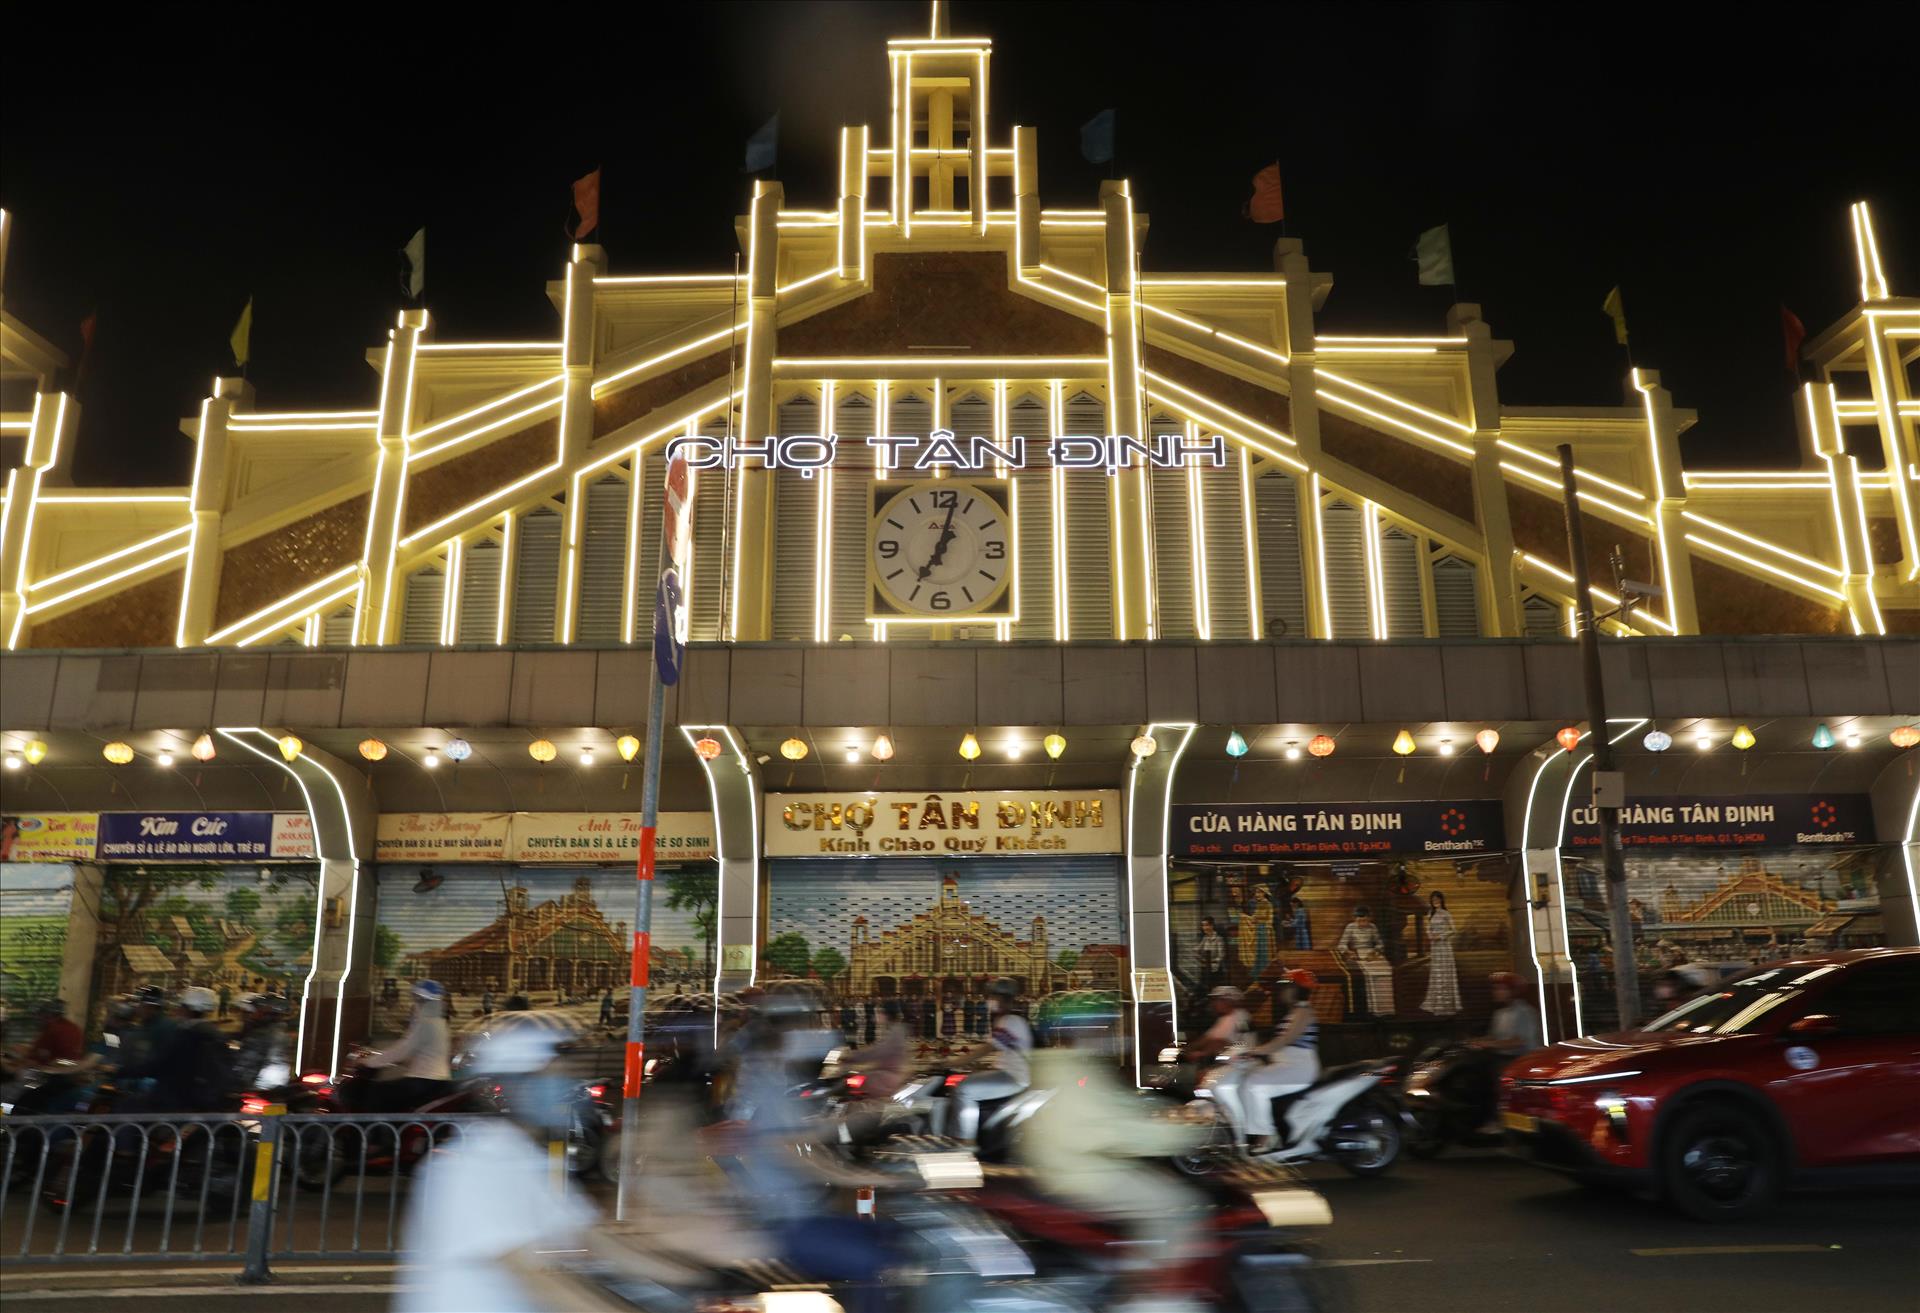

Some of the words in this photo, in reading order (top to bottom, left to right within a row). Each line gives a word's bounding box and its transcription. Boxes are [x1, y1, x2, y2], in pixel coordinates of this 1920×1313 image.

[665, 434, 838, 479] CHỢ
[866, 429, 1025, 469] TÂN
[1048, 435, 1226, 476] ĐỊNH
[929, 491, 958, 508] 12
[878, 540, 899, 558] 9
[985, 541, 1005, 559] 3
[930, 592, 951, 610] 6
[783, 798, 877, 837] CHỢ
[891, 795, 980, 830] TÂN
[996, 799, 1104, 836] ĐỊNH
[1190, 812, 1231, 832] CỬA
[1238, 812, 1297, 832] HÀNG
[1303, 811, 1344, 831] TÂN
[1351, 813, 1402, 834] ĐỊNH
[1618, 804, 1675, 824] HÀNG
[1680, 803, 1720, 823] TÂN
[1725, 805, 1775, 827] ĐỊNH
[139, 817, 178, 836] Kim
[191, 817, 228, 836] Cúc
[528, 836, 568, 848] CHUYÊN
[606, 838, 613, 848] &
[685, 837, 710, 848] SINH
[820, 836, 869, 852] Kính
[879, 836, 936, 851] Chào
[944, 837, 987, 853] Quý
[997, 835, 1067, 850] Khách
